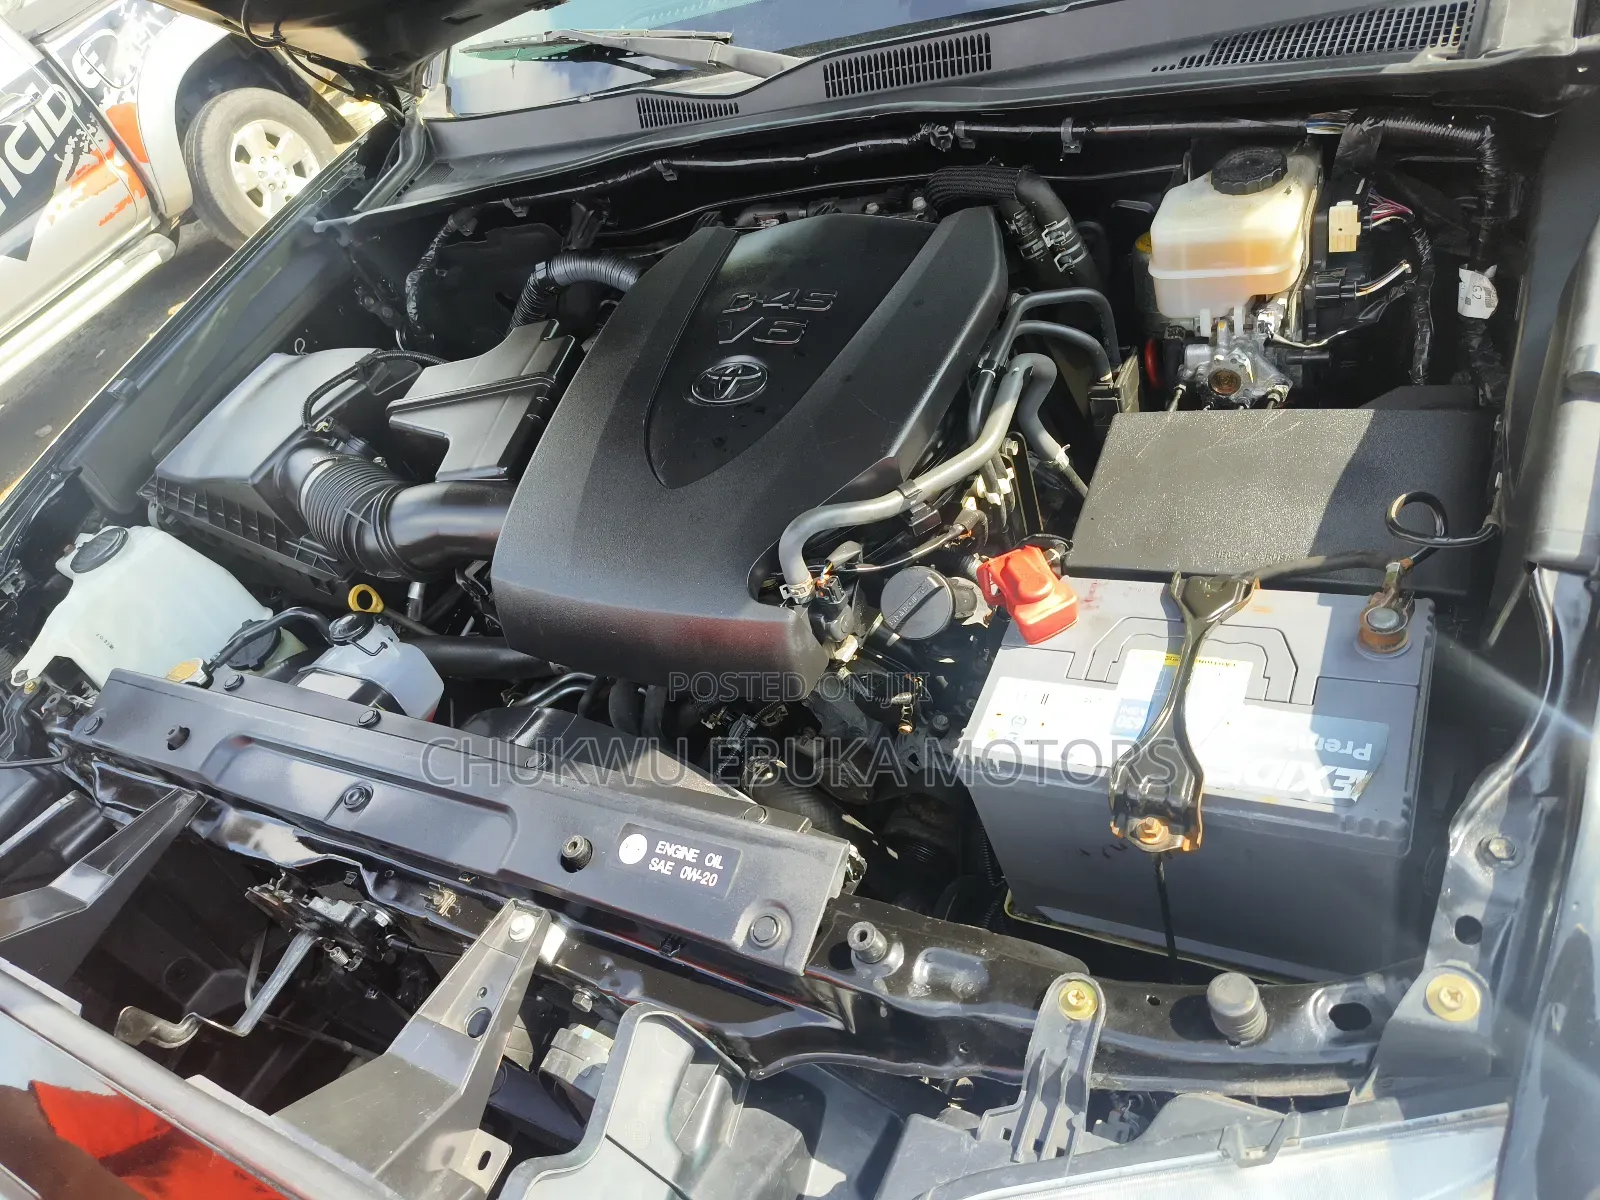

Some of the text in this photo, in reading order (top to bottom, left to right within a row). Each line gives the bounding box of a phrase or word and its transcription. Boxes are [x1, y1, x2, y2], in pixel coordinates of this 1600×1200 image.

[718, 316, 809, 345] V6
[655, 841, 724, 870] ENGINE OIL
[649, 857, 718, 887] SAE 0W-20
